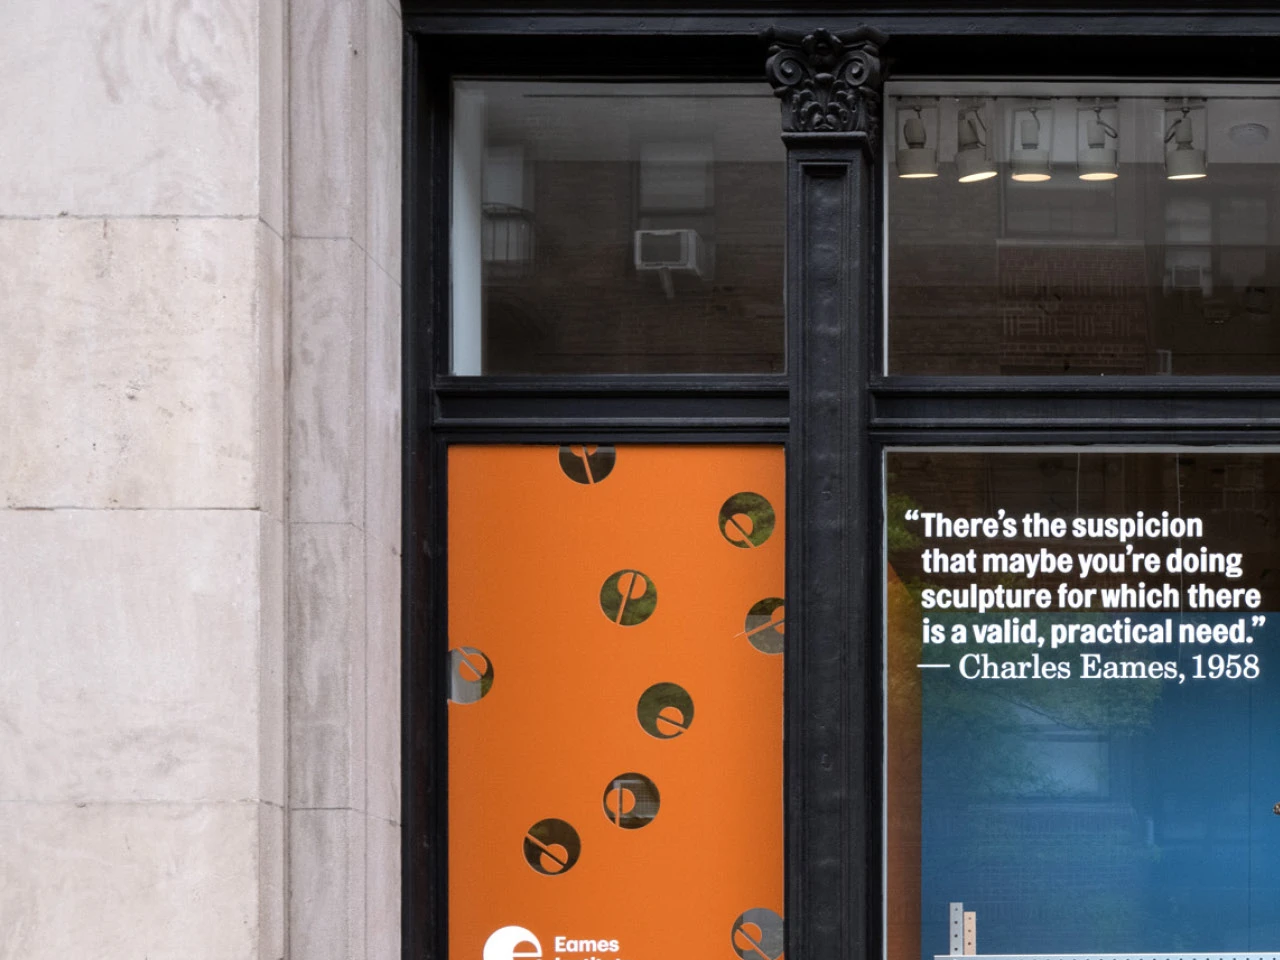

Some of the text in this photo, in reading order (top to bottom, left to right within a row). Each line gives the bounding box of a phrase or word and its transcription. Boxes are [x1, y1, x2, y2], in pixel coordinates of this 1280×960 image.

[905, 509, 1202, 542] “There’s the suspicion
[921, 544, 1243, 578] that maybe you’re doing
[922, 582, 1261, 613] sculpture for which there
[923, 615, 1266, 648] is a valid, practical need.”
[959, 653, 1070, 679] Charles
[1080, 654, 1185, 684] Eames,
[1193, 654, 1260, 678] 1958
[554, 936, 619, 952] Eames
